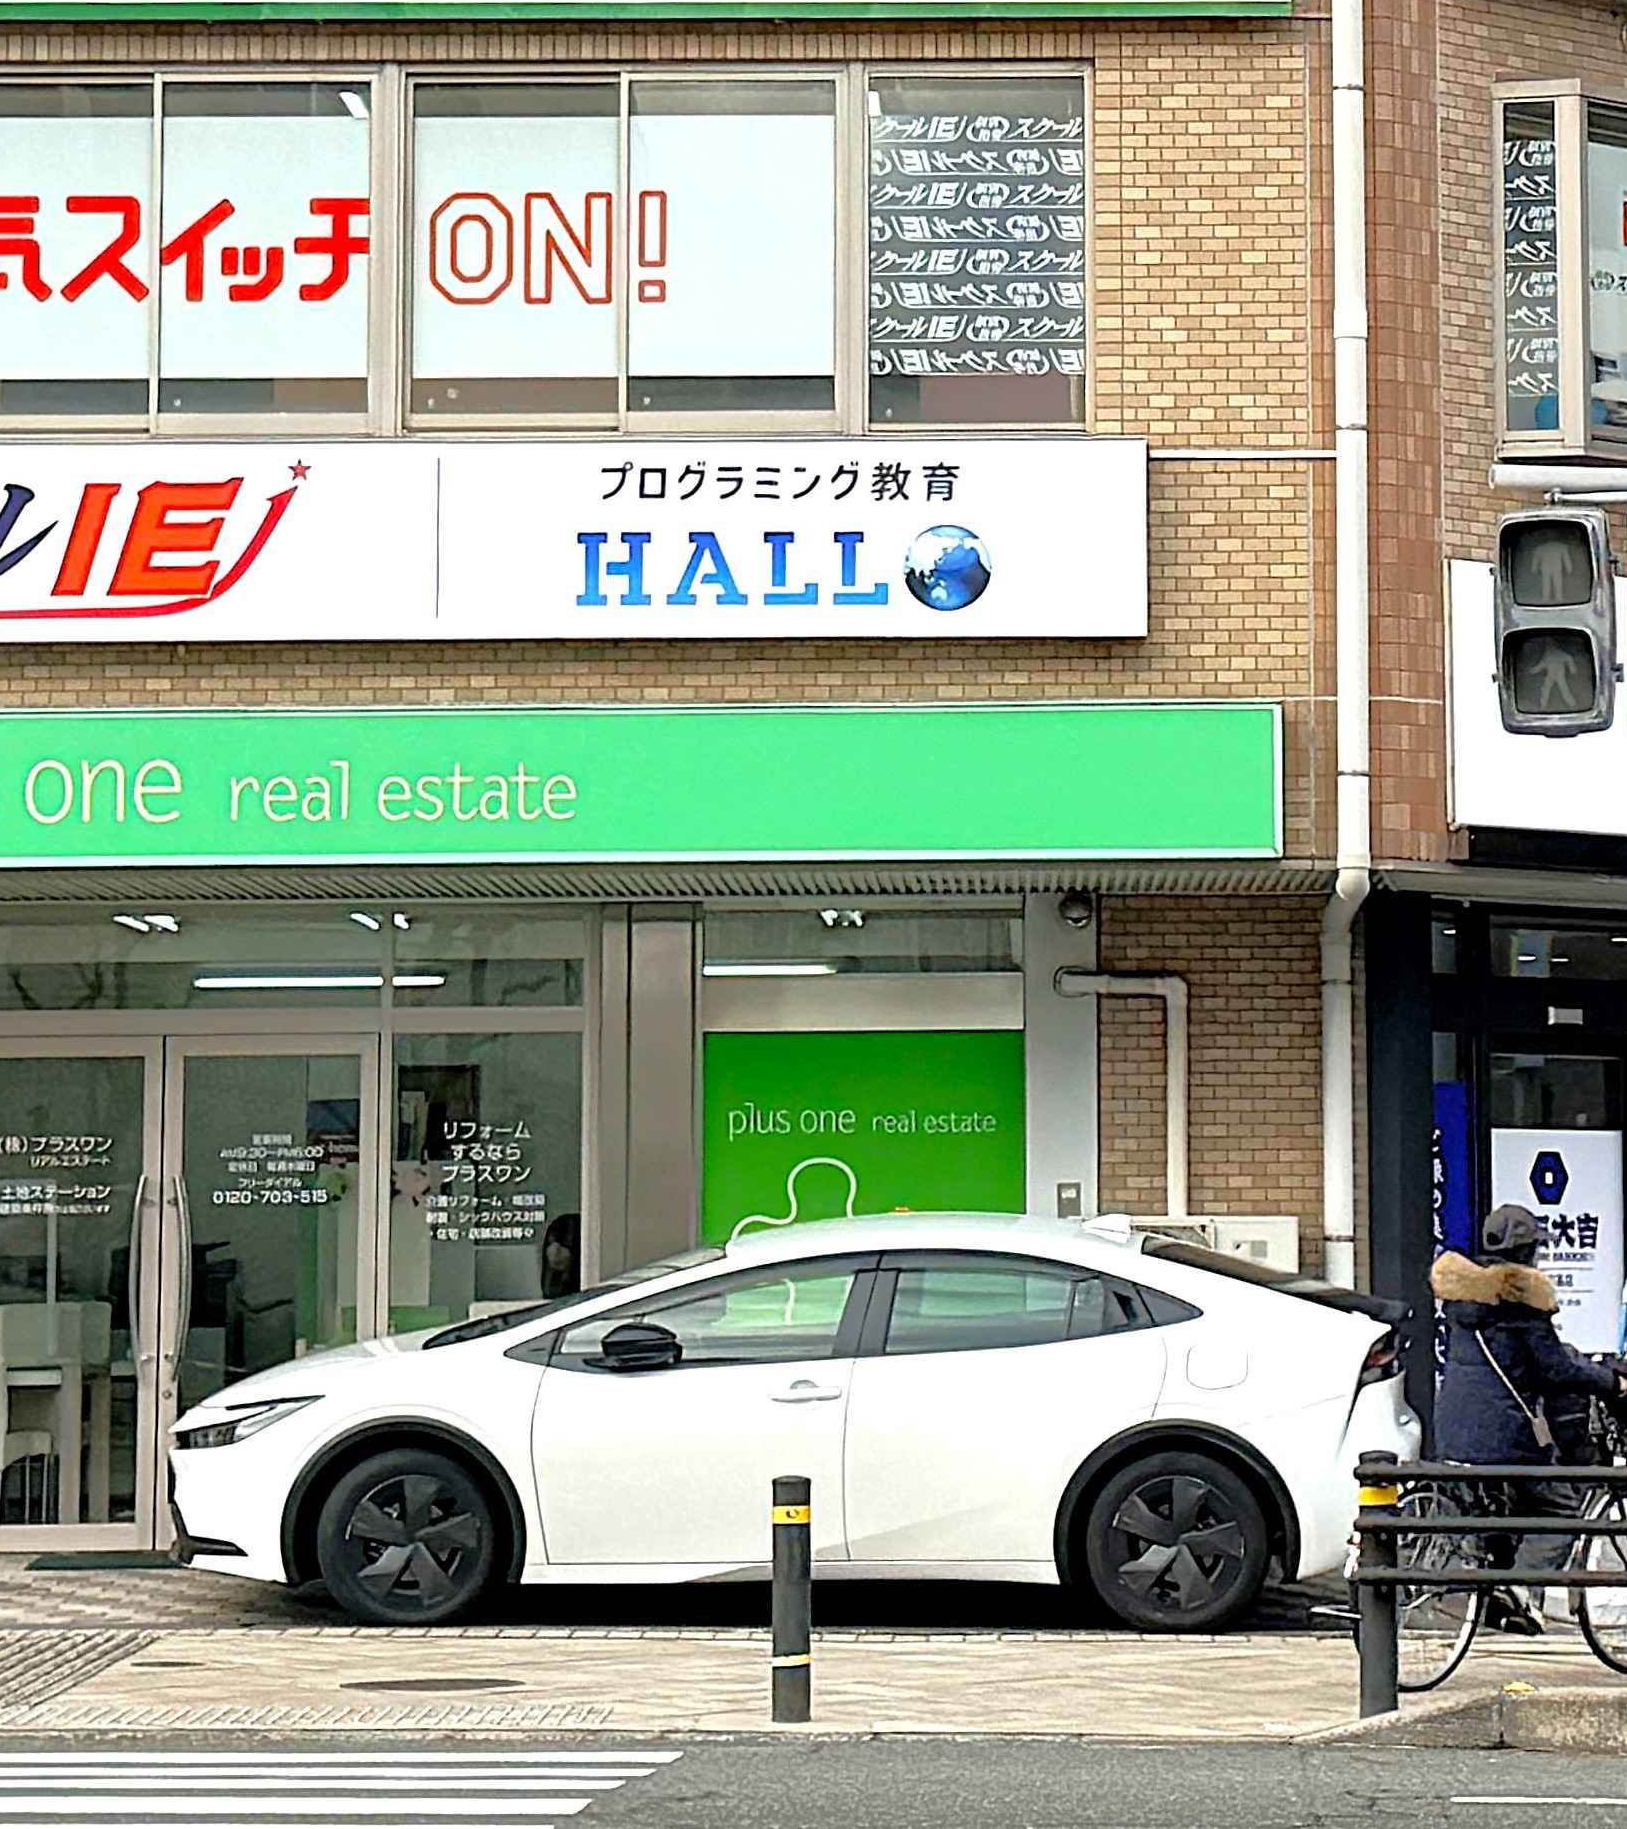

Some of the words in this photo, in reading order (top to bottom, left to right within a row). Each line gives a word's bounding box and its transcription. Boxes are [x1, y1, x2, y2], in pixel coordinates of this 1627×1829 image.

[430, 190, 666, 304] ON!
[600, 462, 962, 503] プログラミング教育
[25, 757, 182, 824] one
[230, 763, 349, 822] real
[378, 764, 577, 822] estate
[443, 1121, 531, 1140] リフォーム
[728, 1102, 791, 1141] plus
[800, 1108, 856, 1134] one
[872, 1110, 915, 1133] real
[924, 1111, 997, 1133] estate
[442, 1166, 532, 1183] プラスワン
